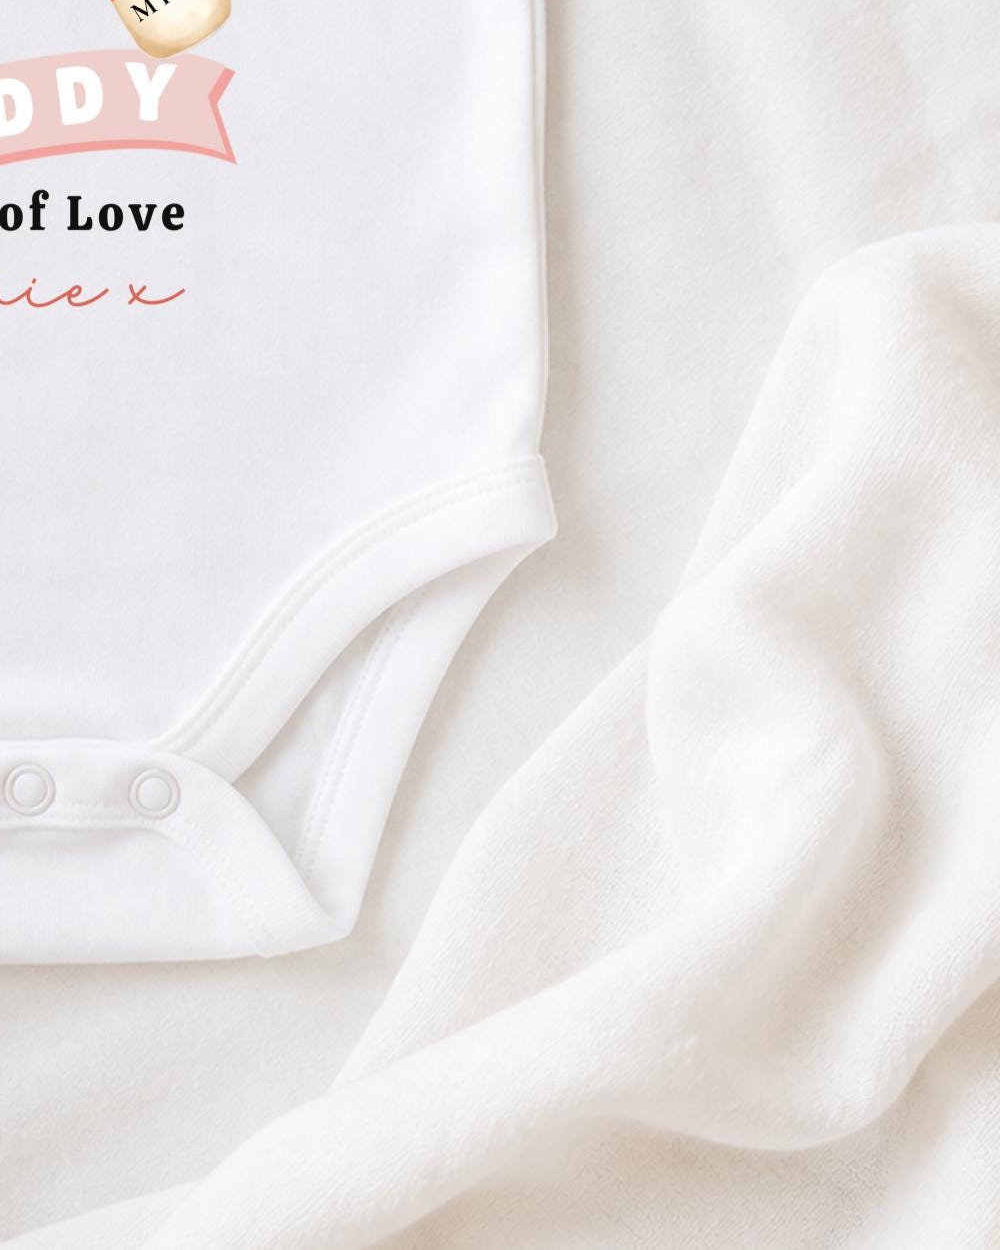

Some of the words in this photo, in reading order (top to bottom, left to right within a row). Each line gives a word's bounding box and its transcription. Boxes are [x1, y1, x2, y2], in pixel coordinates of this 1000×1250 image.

[0, 190, 50, 232] of
[67, 195, 185, 232] Love
[128, 284, 185, 306] x
